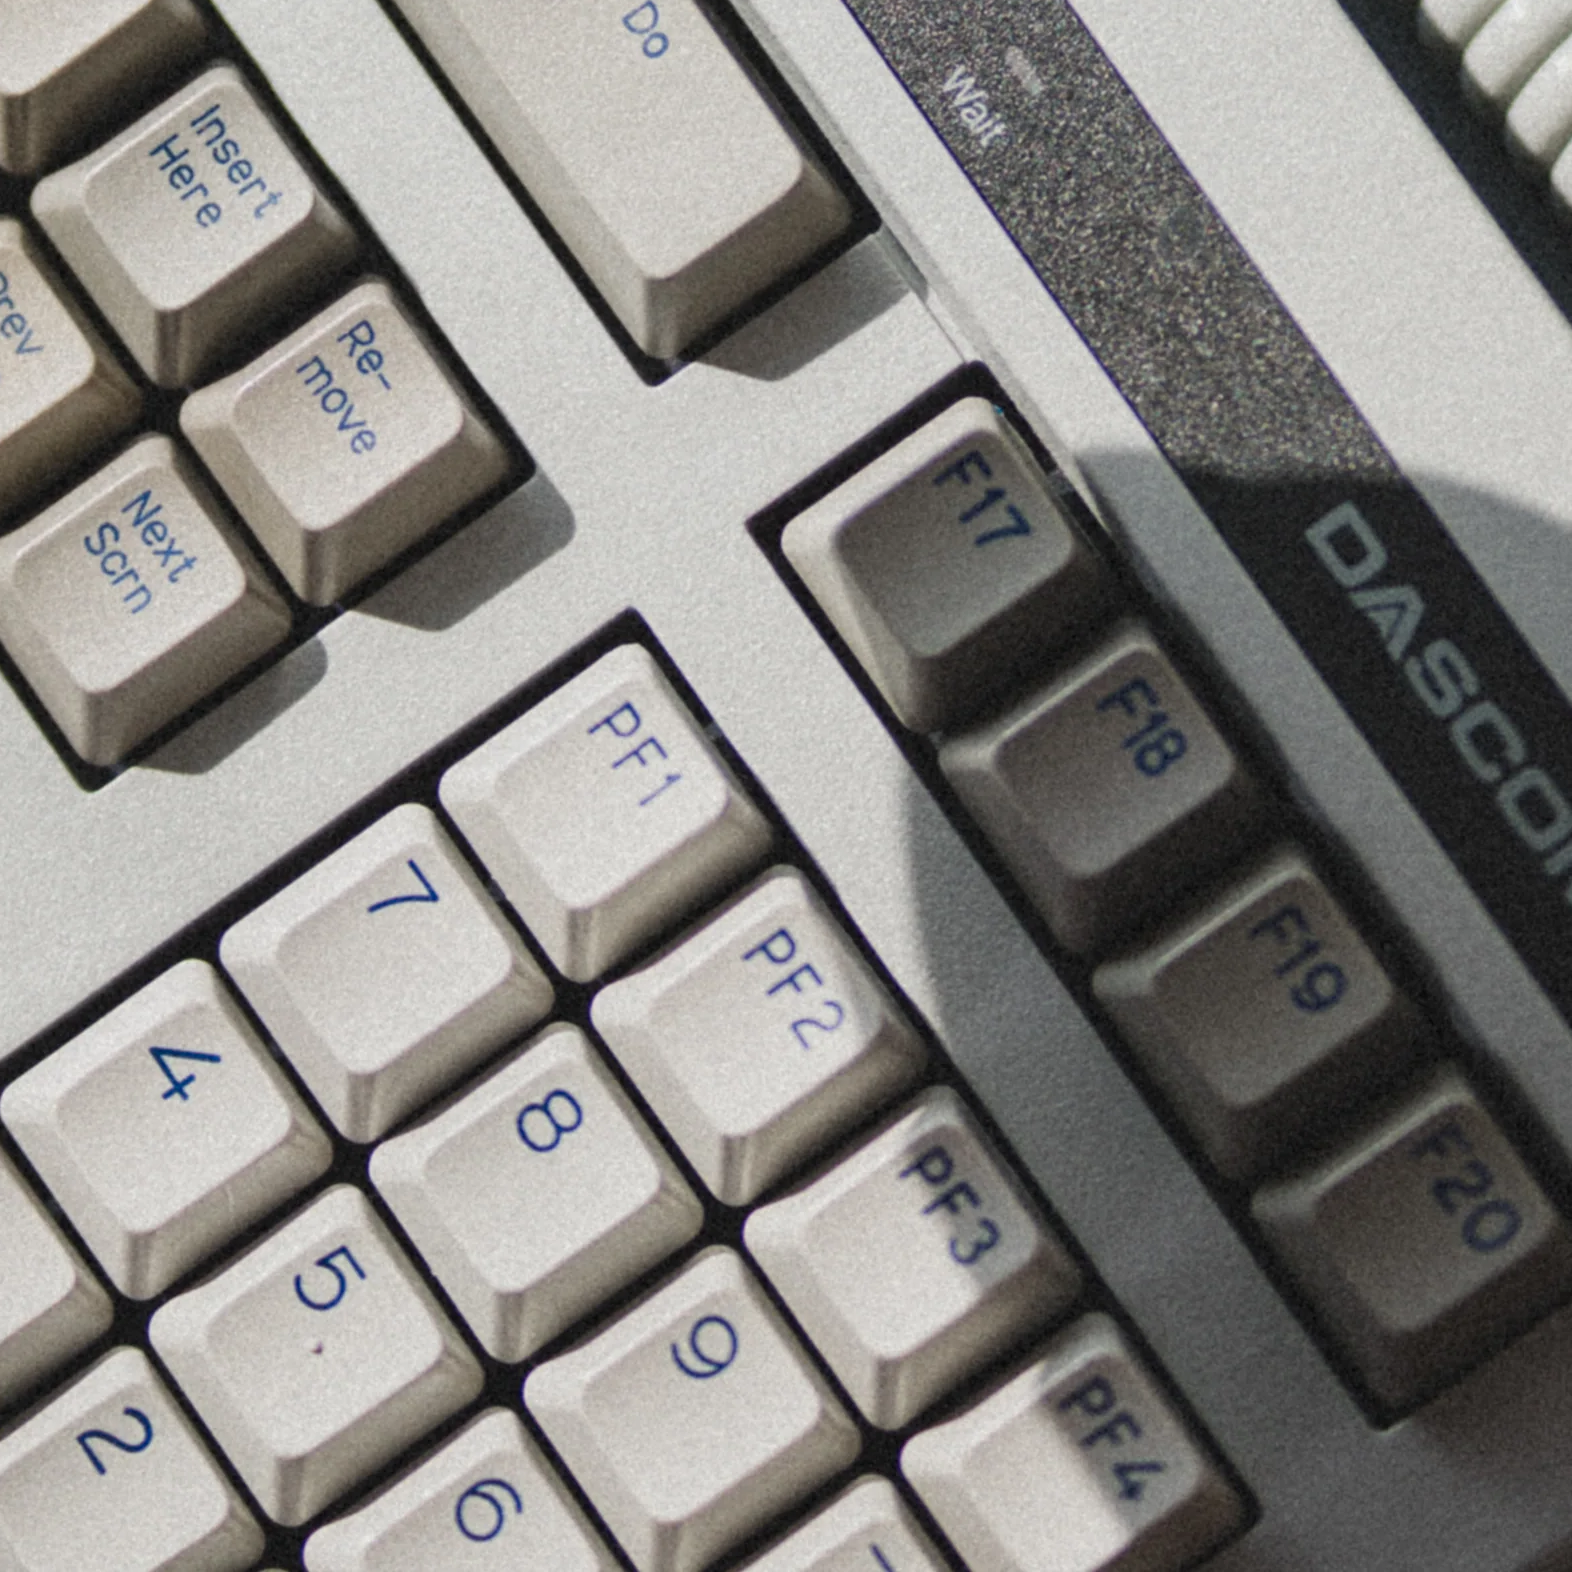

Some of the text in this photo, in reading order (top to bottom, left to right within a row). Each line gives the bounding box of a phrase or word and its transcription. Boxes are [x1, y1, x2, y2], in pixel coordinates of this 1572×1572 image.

[621, 0, 672, 60] Do
[941, 68, 1006, 150] Wait
[148, 133, 223, 228] Here
[189, 105, 285, 220] Insert
[336, 319, 393, 392] Re-
[295, 357, 377, 455] move
[120, 490, 198, 583] Next
[932, 448, 1032, 549] F17
[83, 523, 154, 616] Scrn
[587, 701, 682, 807] PF1
[1096, 677, 1189, 779] F18
[368, 859, 440, 913] 7
[741, 927, 845, 1050] PF2
[1248, 907, 1350, 1015] F19
[148, 1046, 222, 1101] 4
[516, 1088, 583, 1154] 8
[899, 1146, 1001, 1266] PF3
[1411, 1127, 1525, 1256] F20
[293, 1245, 367, 1312] 5
[670, 1314, 739, 1380] 9
[76, 1407, 154, 1475] 2
[1056, 1375, 1167, 1501] PF4
[454, 1478, 523, 1543] 6
